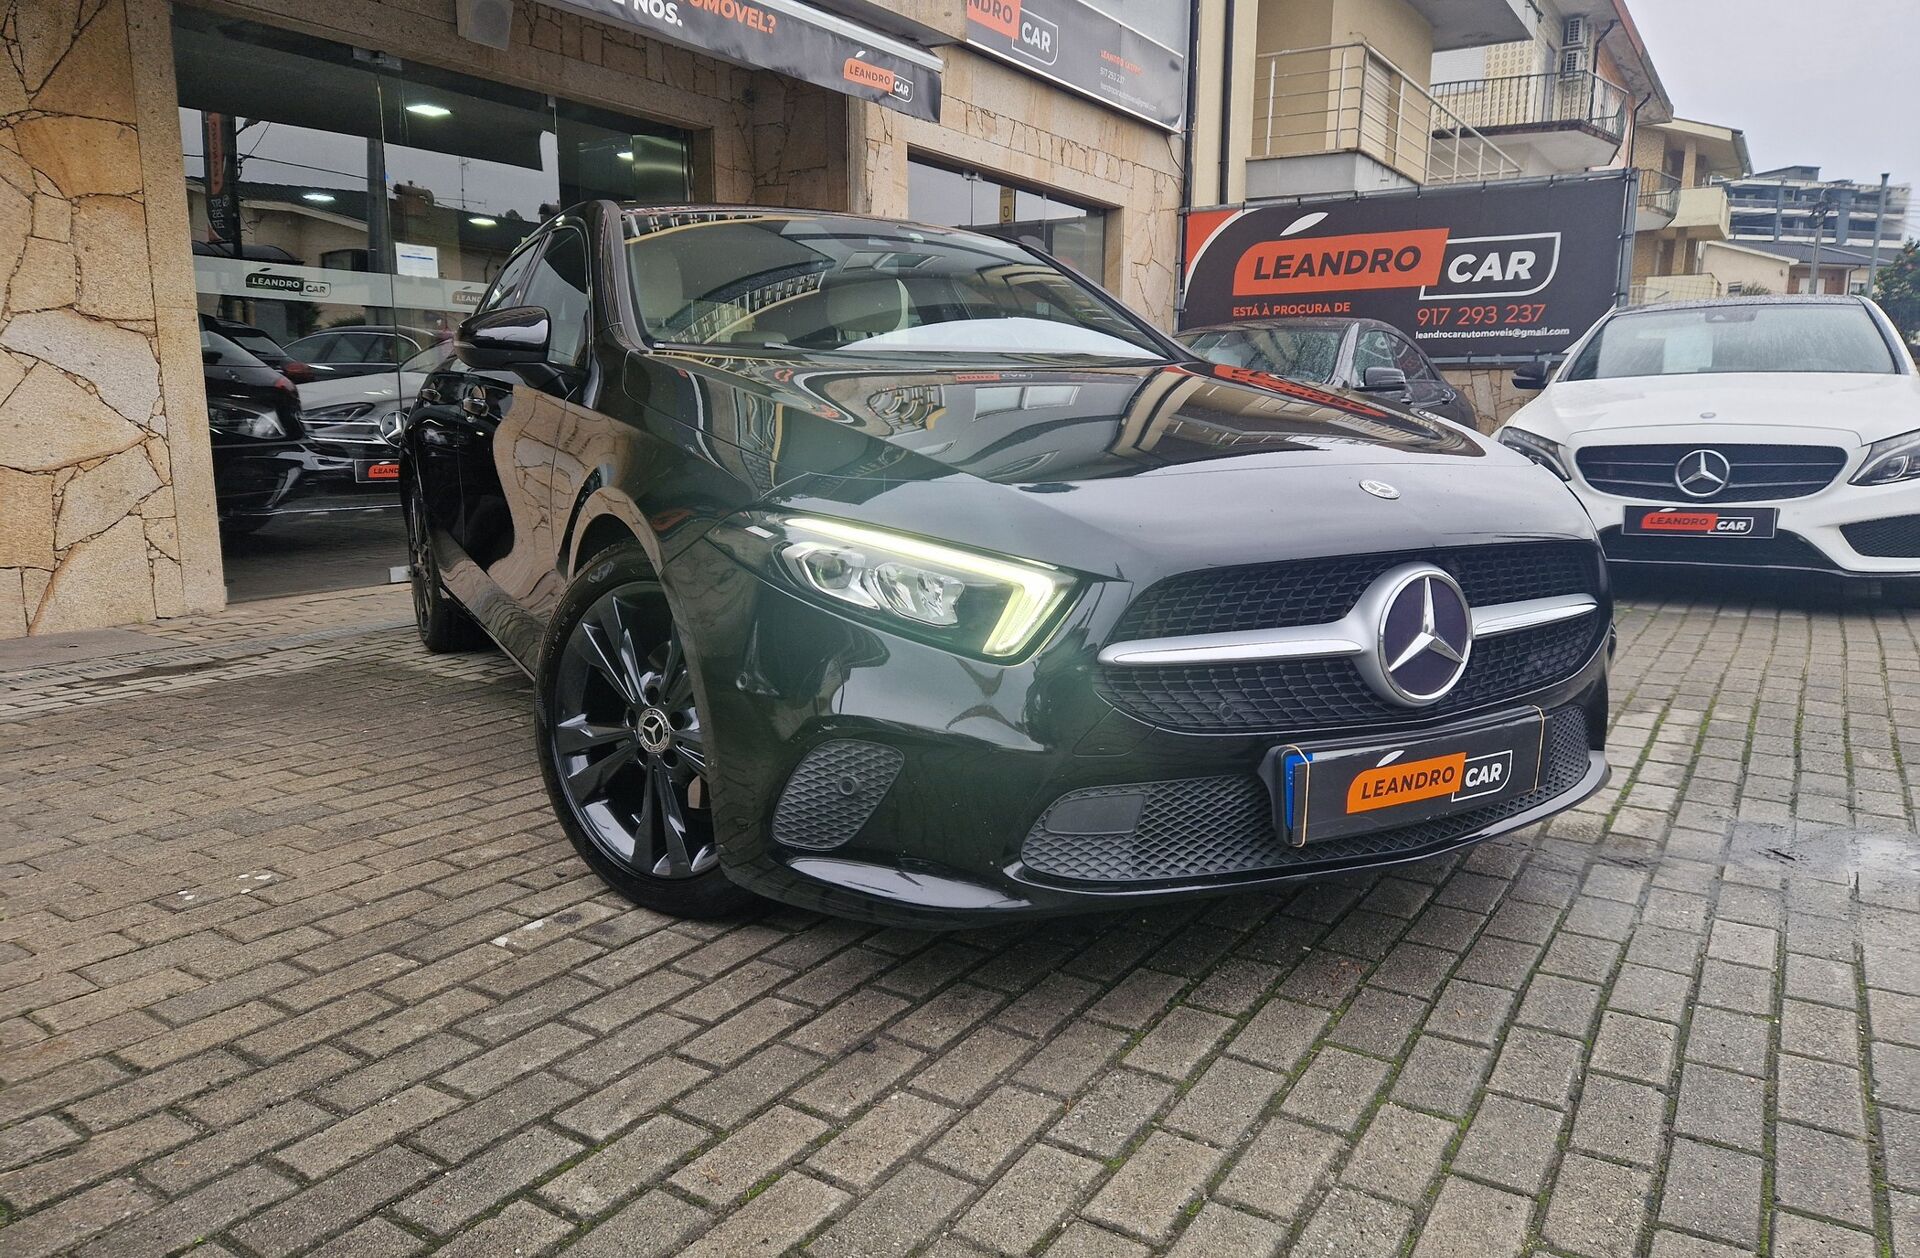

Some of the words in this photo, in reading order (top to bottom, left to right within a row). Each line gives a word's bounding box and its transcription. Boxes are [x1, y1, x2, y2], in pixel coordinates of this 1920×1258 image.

[1021, 21, 1051, 53] CAR
[849, 64, 891, 85] LEANDRO
[895, 80, 909, 97] CAR
[1254, 245, 1422, 281] LEANDRO
[1447, 250, 1536, 284] CAR
[252, 277, 300, 289] LEANDRO
[305, 285, 327, 294] CAR
[1232, 303, 1260, 317] ESTÁ
[1262, 302, 1271, 316] À
[1273, 303, 1331, 315] PROCURA
[1334, 302, 1351, 313] DE
[1417, 307, 1452, 327] 917
[1456, 305, 1498, 326] 293
[1503, 303, 1547, 324] 237
[1415, 327, 1570, 340] leandrocarautomoveis@gmail.com
[1649, 516, 1709, 526] LEANDRO
[1716, 520, 1747, 531] CAR
[1360, 766, 1456, 800] LEANDRO
[1465, 762, 1502, 788] CAR
